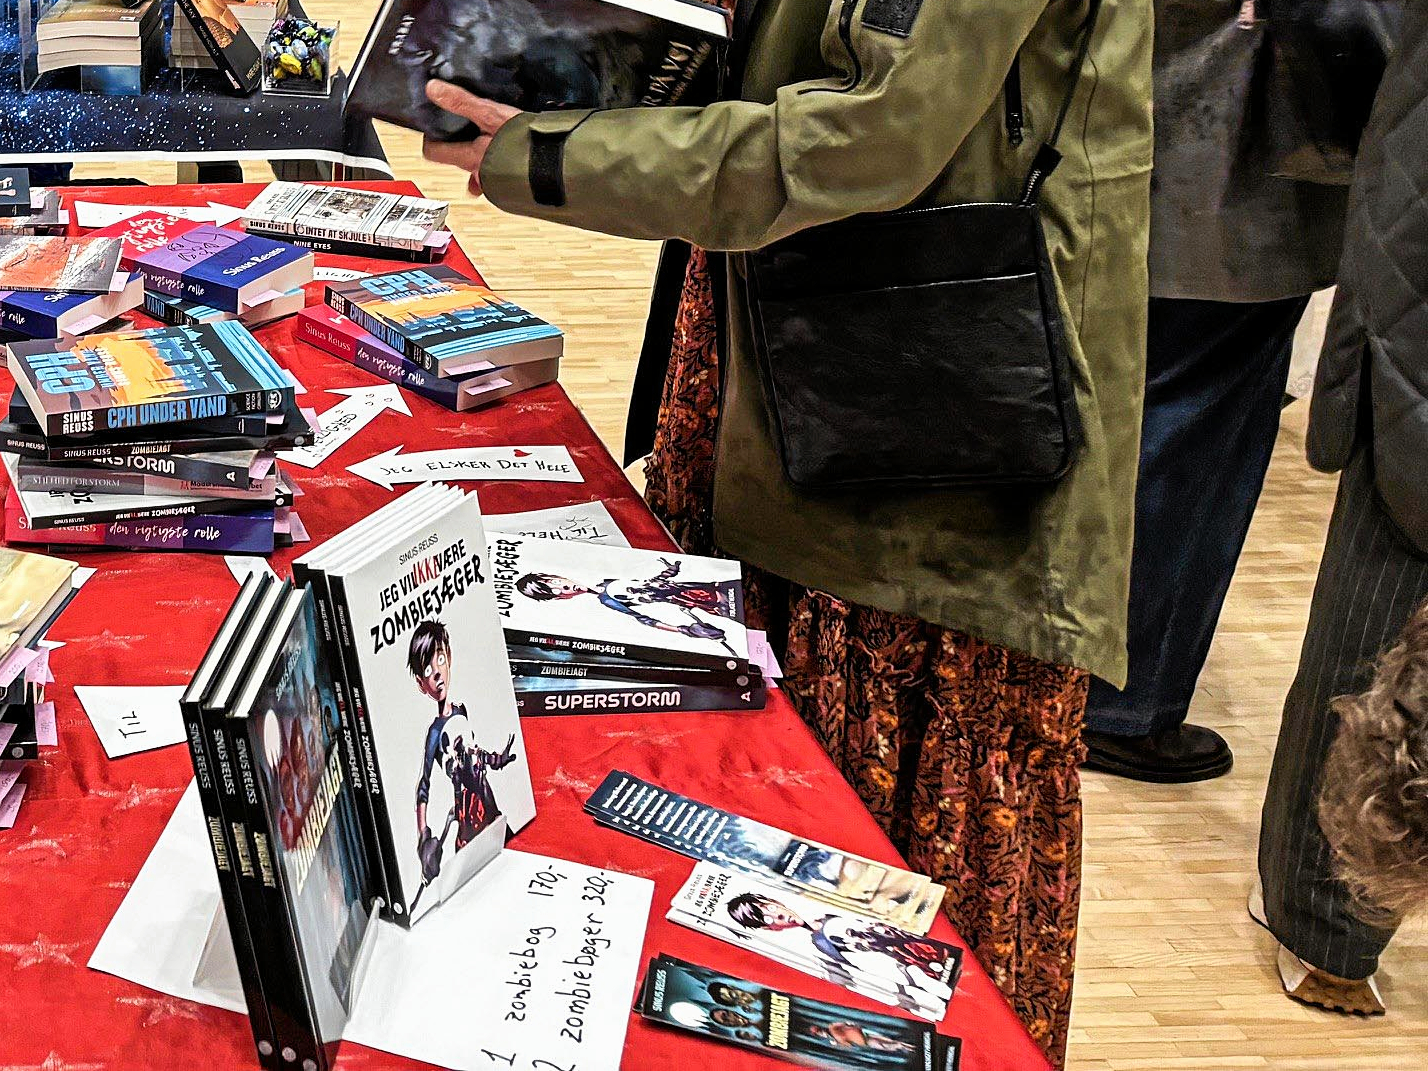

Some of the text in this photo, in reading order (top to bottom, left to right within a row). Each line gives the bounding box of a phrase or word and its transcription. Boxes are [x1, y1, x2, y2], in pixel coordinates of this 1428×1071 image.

[293, 240, 332, 250] NINE EYES
[305, 226, 367, 242] INTET AT SKJULE
[222, 261, 252, 276] Sinus
[187, 284, 205, 296] rolle
[359, 269, 440, 296] CPH
[305, 322, 351, 352] Sinus Reuss
[349, 304, 405, 354] CPH UNDER VAND
[25, 351, 95, 394] CPH
[63, 411, 93, 424] SINUS
[107, 395, 227, 429] CPH UNDER VAND
[63, 421, 94, 434] REUSS
[7, 439, 45, 451] SINUS REUSS
[64, 444, 172, 458] SINUS REUSS ZOMBIEJAGT
[380, 466, 413, 476] JEG
[426, 460, 492, 472] ELSKER
[90, 478, 120, 487] STORM
[110, 522, 221, 542] den vigtigste rolle
[399, 533, 439, 565] SINUS REUSS
[380, 584, 399, 611] JEG
[437, 539, 466, 572] VÆRE
[371, 554, 485, 654] ZOMBIEJÆGER
[572, 641, 625, 655] ZOMBIEJÆGER
[540, 666, 589, 677] ZOMBIEJAGT
[544, 691, 681, 710] SUPERSTORM
[189, 722, 202, 756] SINUS
[196, 755, 212, 789] REUSS
[213, 729, 236, 795] SINUS REUSS
[236, 738, 258, 805] SINUS REUSS
[293, 739, 344, 897] ZOMBIEJAGT
[555, 913, 611, 1043] zombiebøger
[481, 1049, 517, 1066] 1
[505, 926, 557, 1022] zombiebog
[769, 994, 790, 1050] ZOMBIEJAGT
